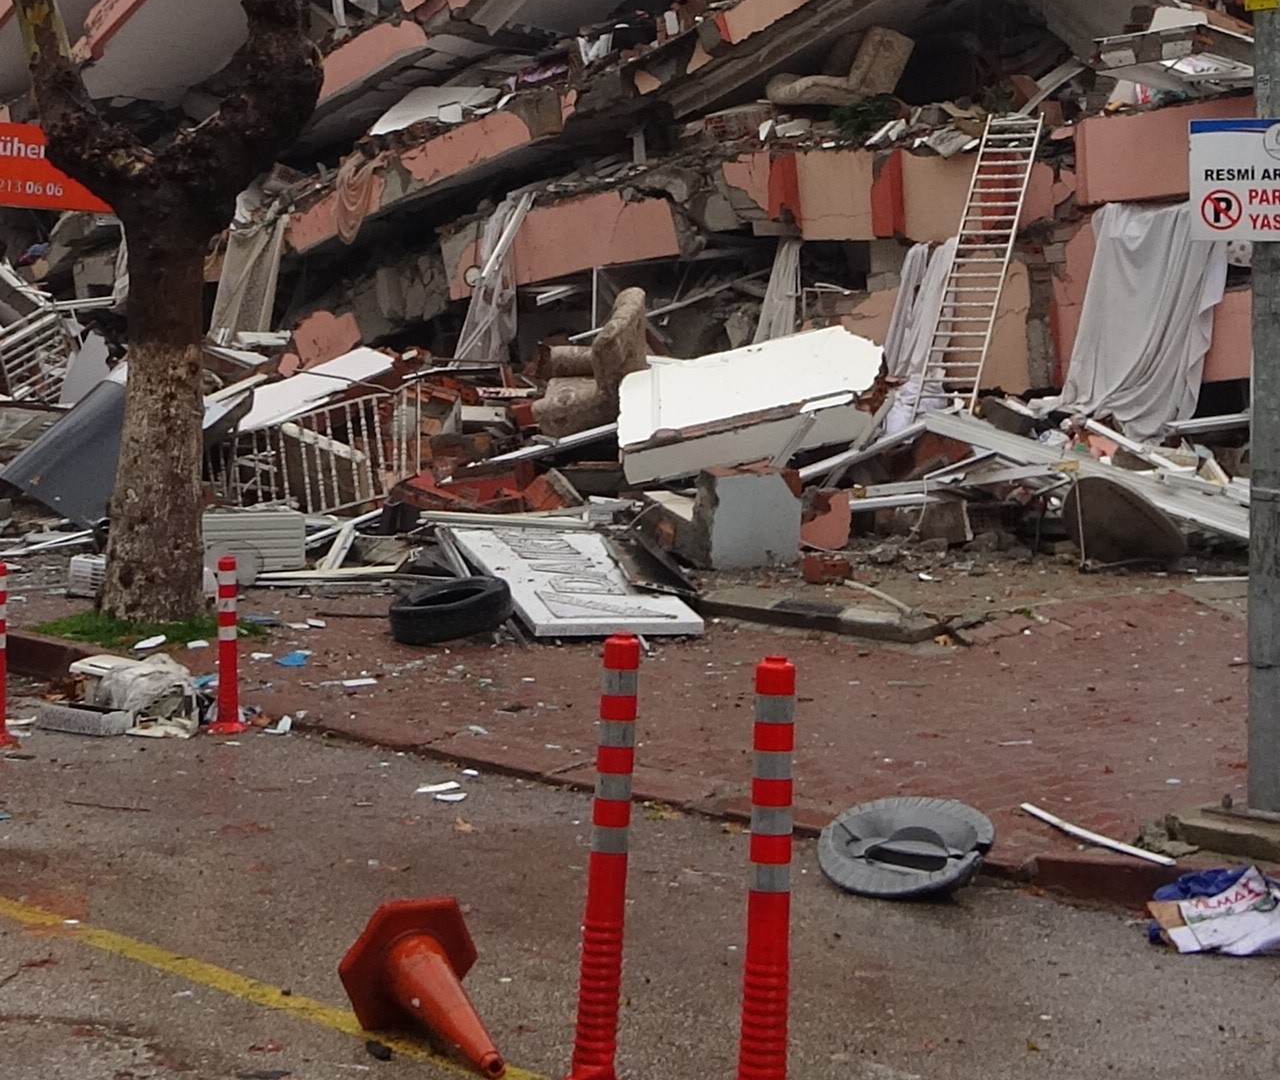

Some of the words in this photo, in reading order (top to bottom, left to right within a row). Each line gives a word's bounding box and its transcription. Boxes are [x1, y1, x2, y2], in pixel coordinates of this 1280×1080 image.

[1204, 165, 1255, 182] RESMİ
[25, 180, 43, 195] 06
[46, 182, 64, 197] 06
